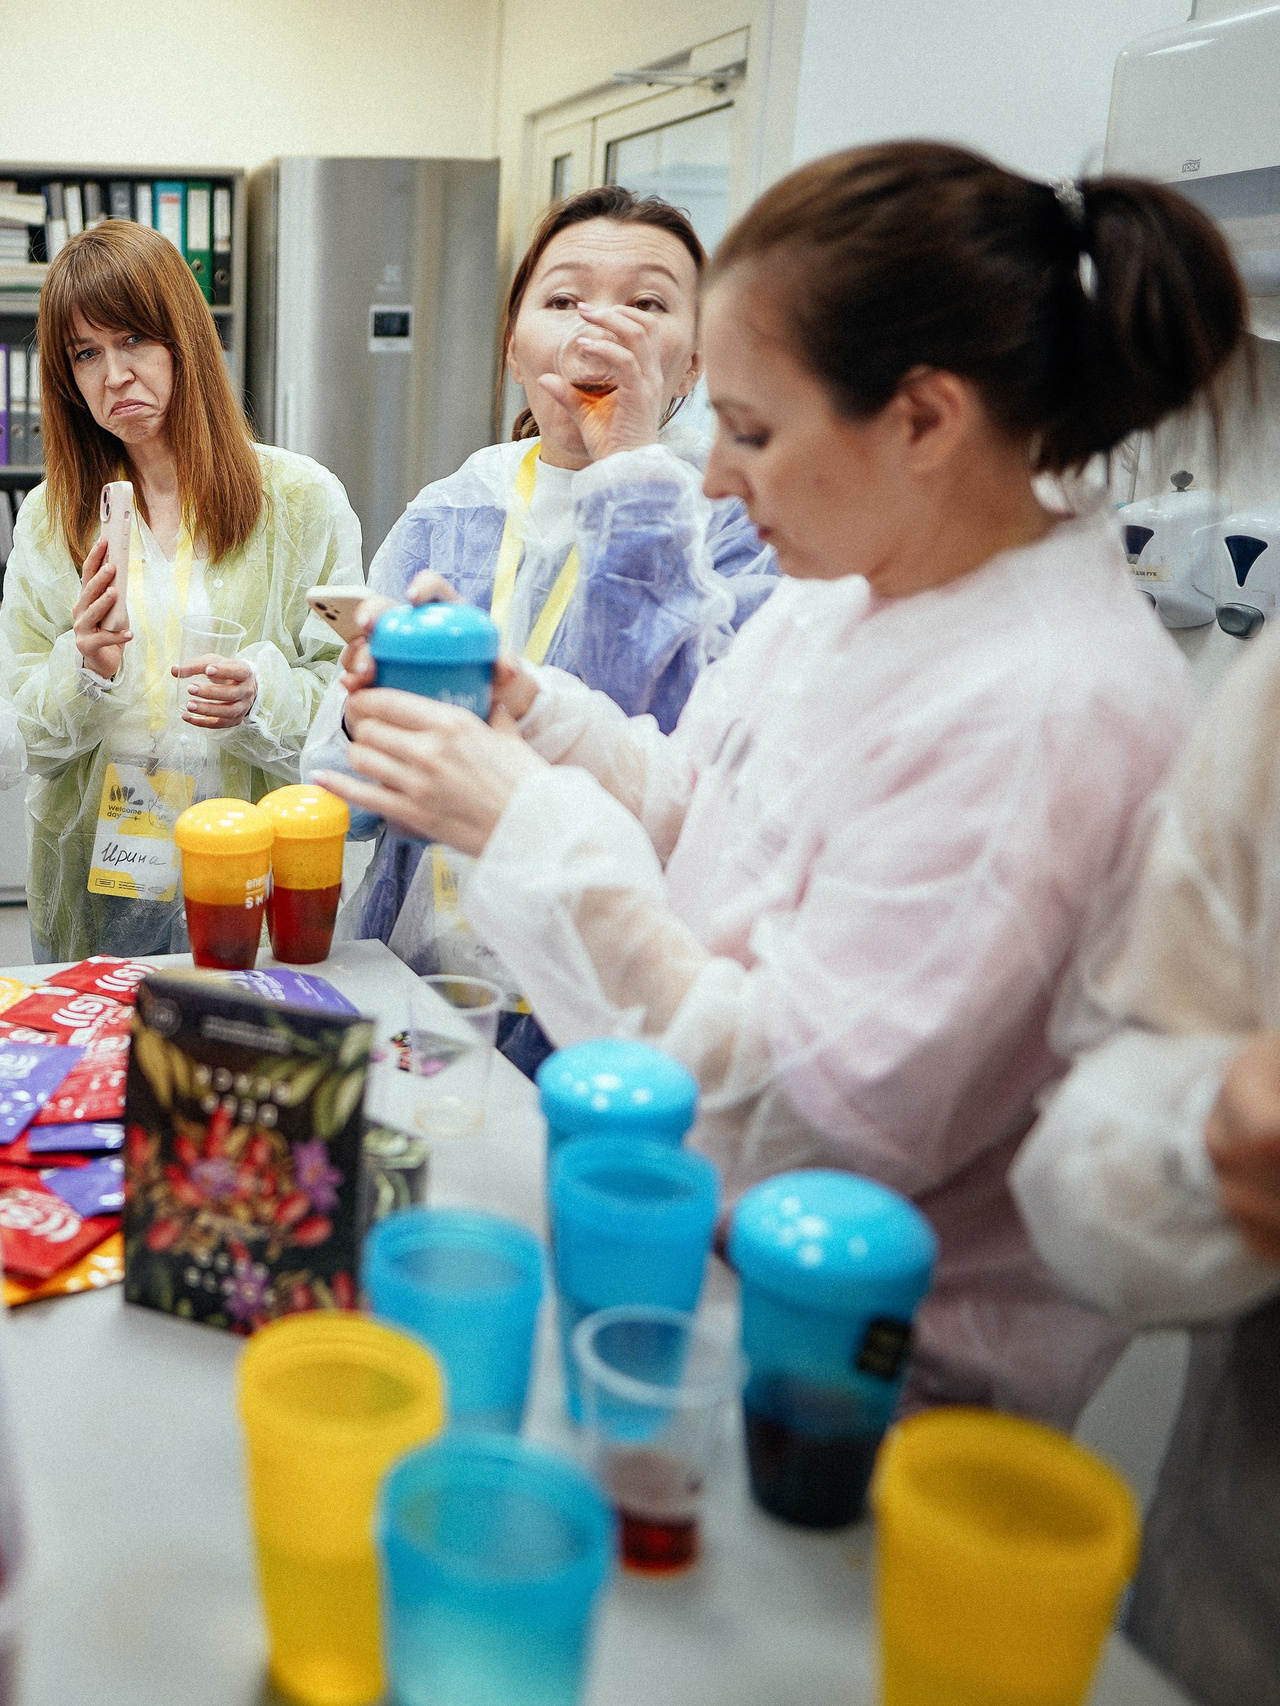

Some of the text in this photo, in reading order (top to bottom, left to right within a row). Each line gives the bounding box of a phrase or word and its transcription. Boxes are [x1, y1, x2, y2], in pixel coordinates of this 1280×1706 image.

[107, 811, 121, 819] day
[108, 804, 142, 815] Welcome
[101, 842, 167, 866] Ирина
